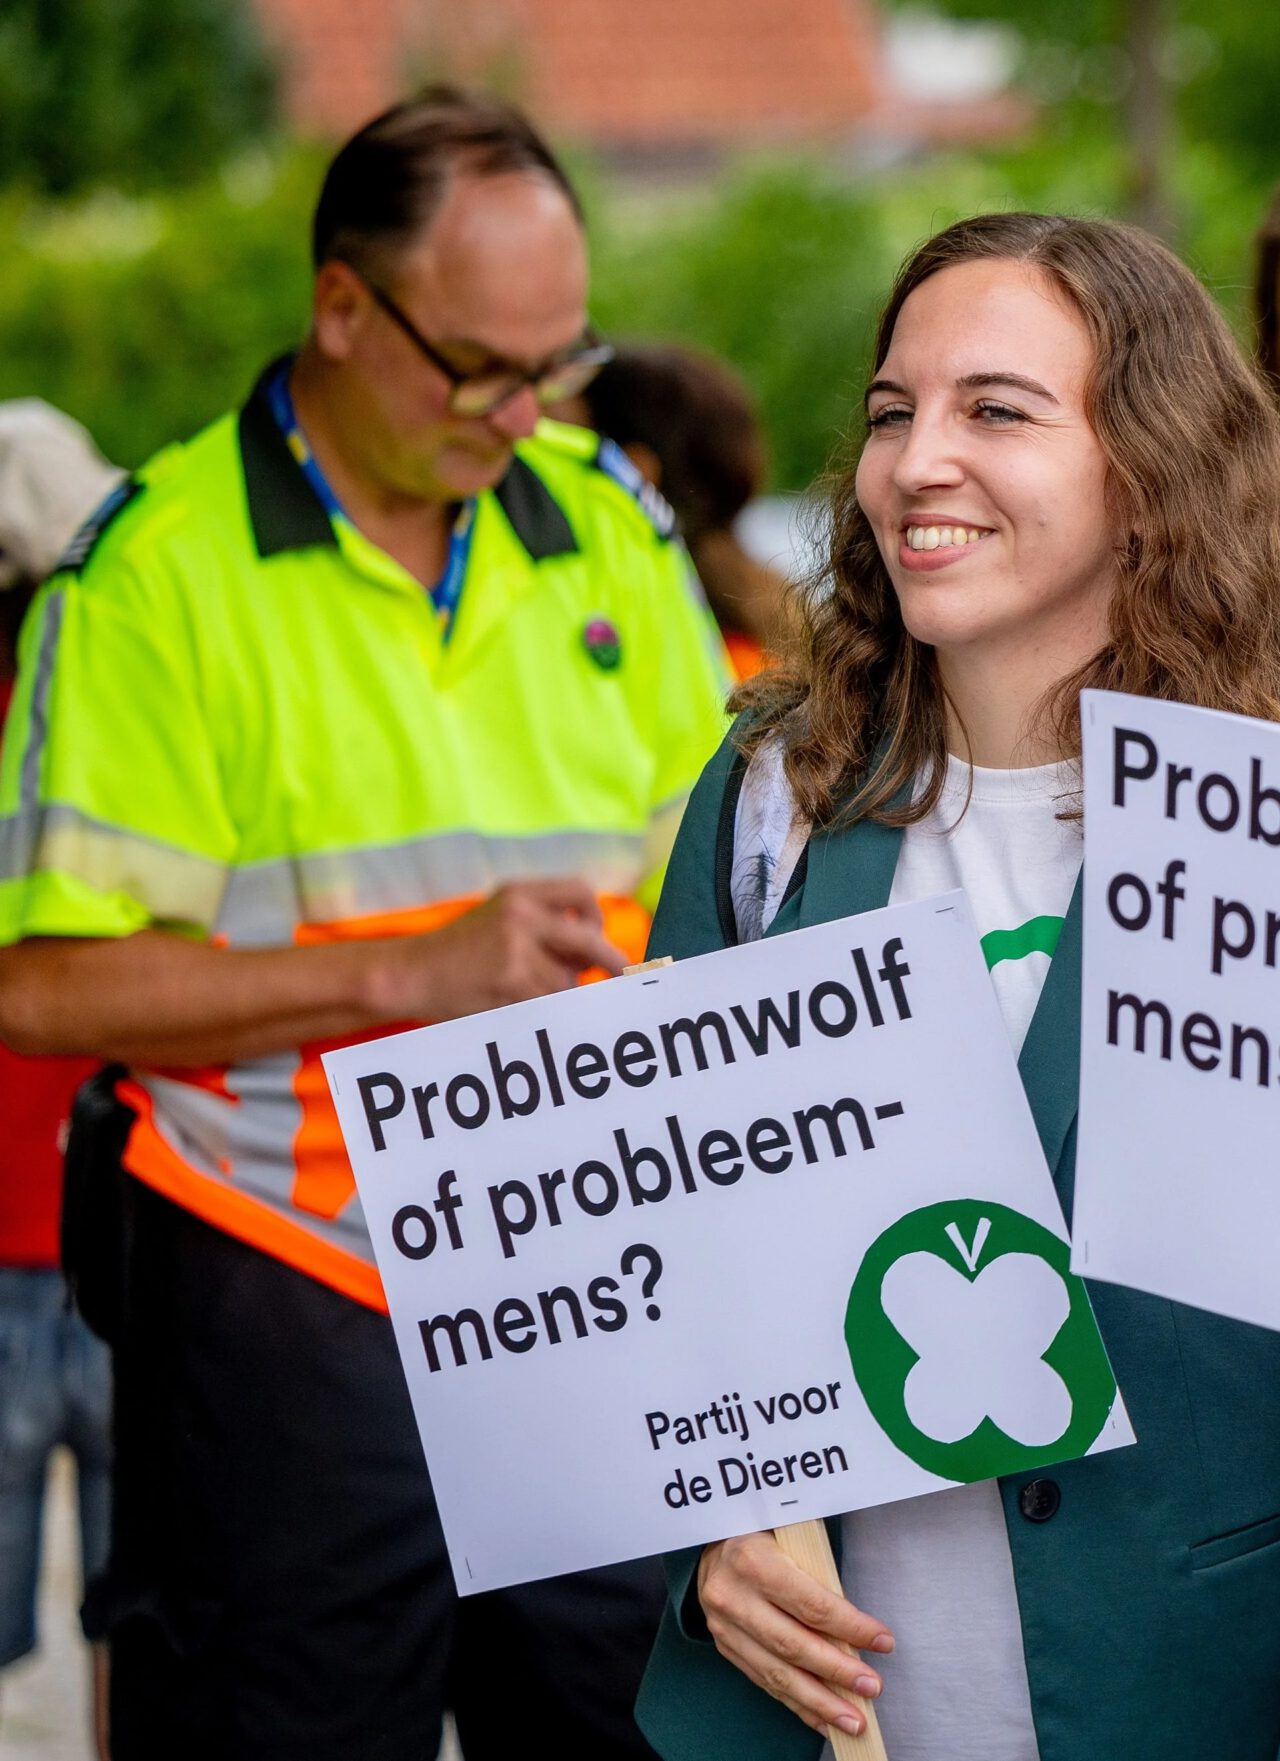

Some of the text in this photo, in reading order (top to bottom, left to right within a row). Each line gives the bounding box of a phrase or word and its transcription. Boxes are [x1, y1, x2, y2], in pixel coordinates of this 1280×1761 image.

[1107, 859, 1186, 941] of
[356, 937, 914, 1152] Probleemwolf
[391, 1097, 906, 1261] of probleem-
[417, 1243, 664, 1374] mens?
[644, 1380, 842, 1451] Partij voor
[663, 1444, 850, 1509] de Dieren
